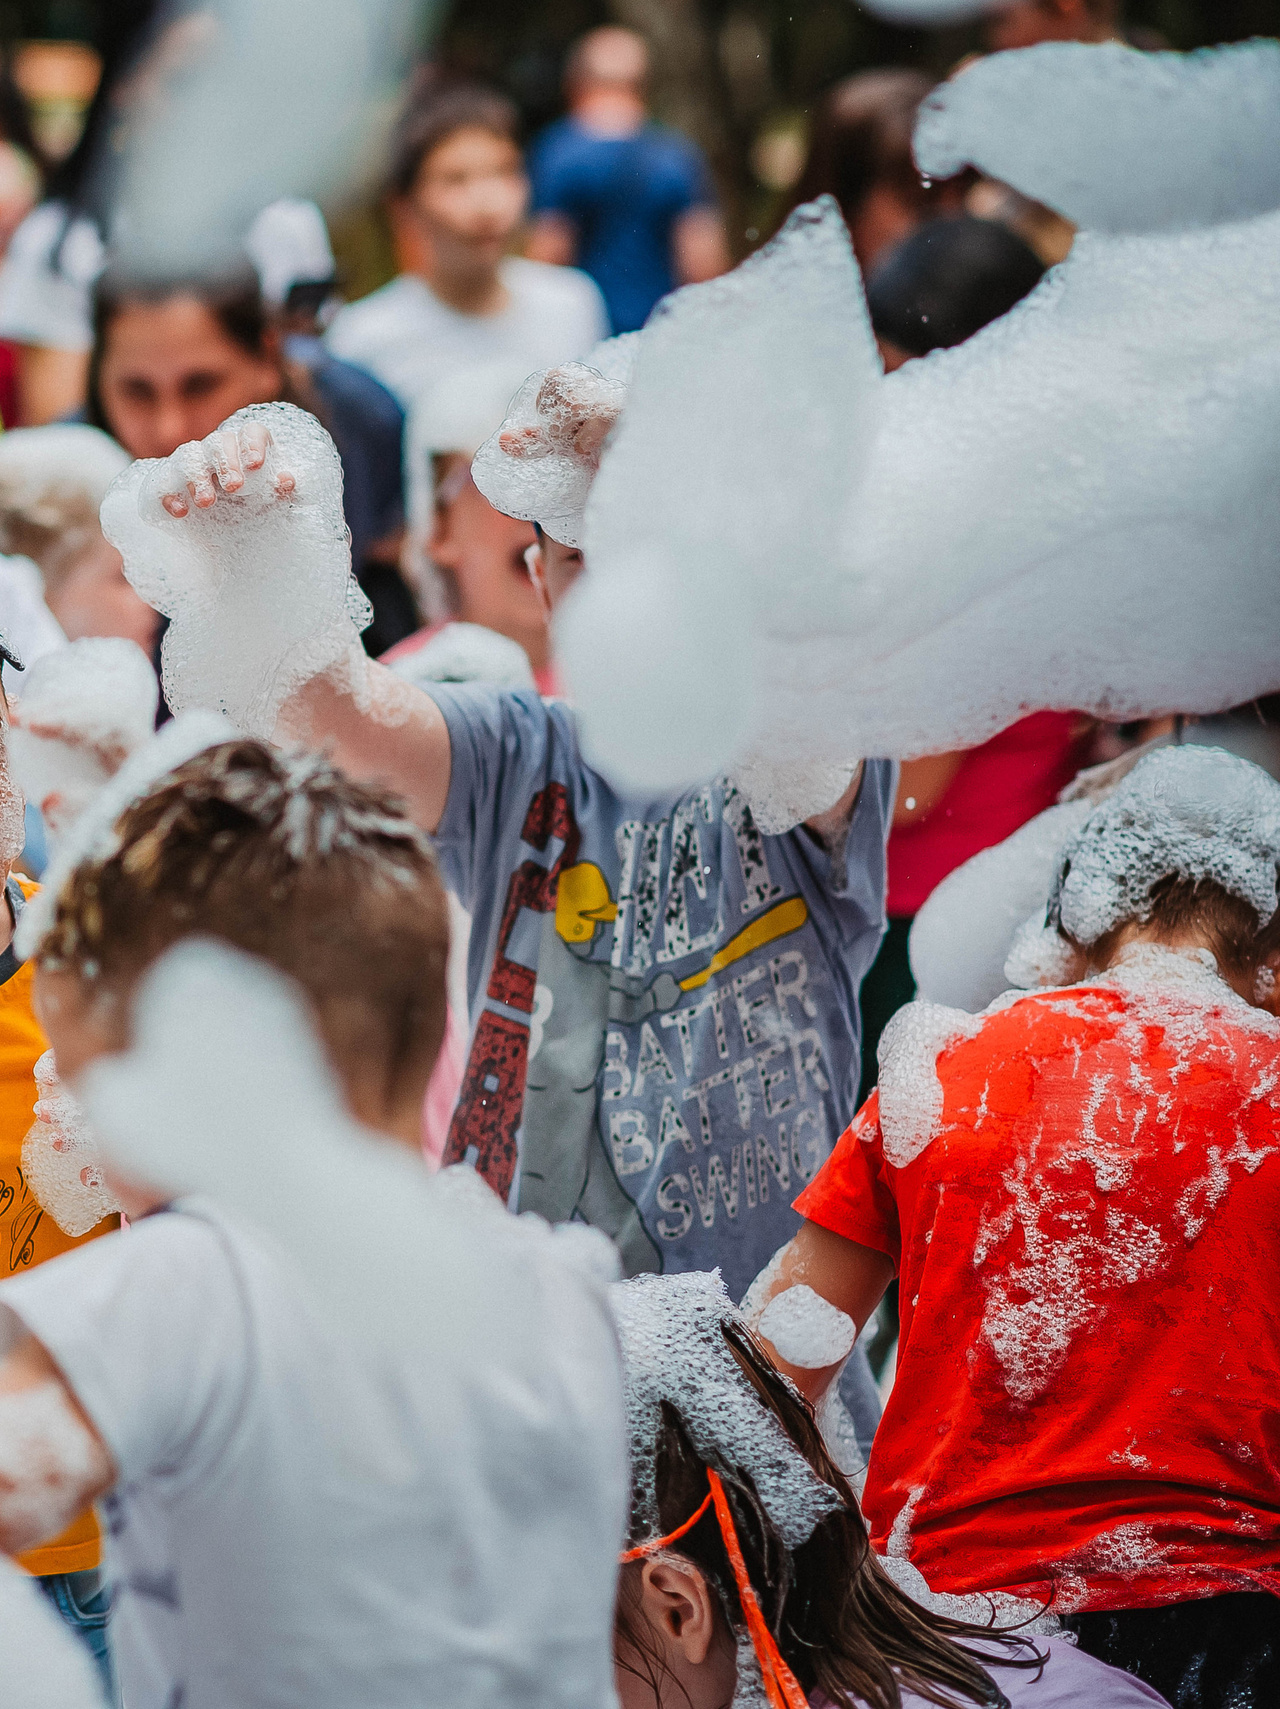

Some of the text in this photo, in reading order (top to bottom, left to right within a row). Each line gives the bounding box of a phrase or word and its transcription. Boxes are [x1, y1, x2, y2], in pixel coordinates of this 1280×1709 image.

[602, 950, 817, 1100] BATTER
[608, 1027, 830, 1175] BATTER
[655, 1106, 822, 1241] SWING
